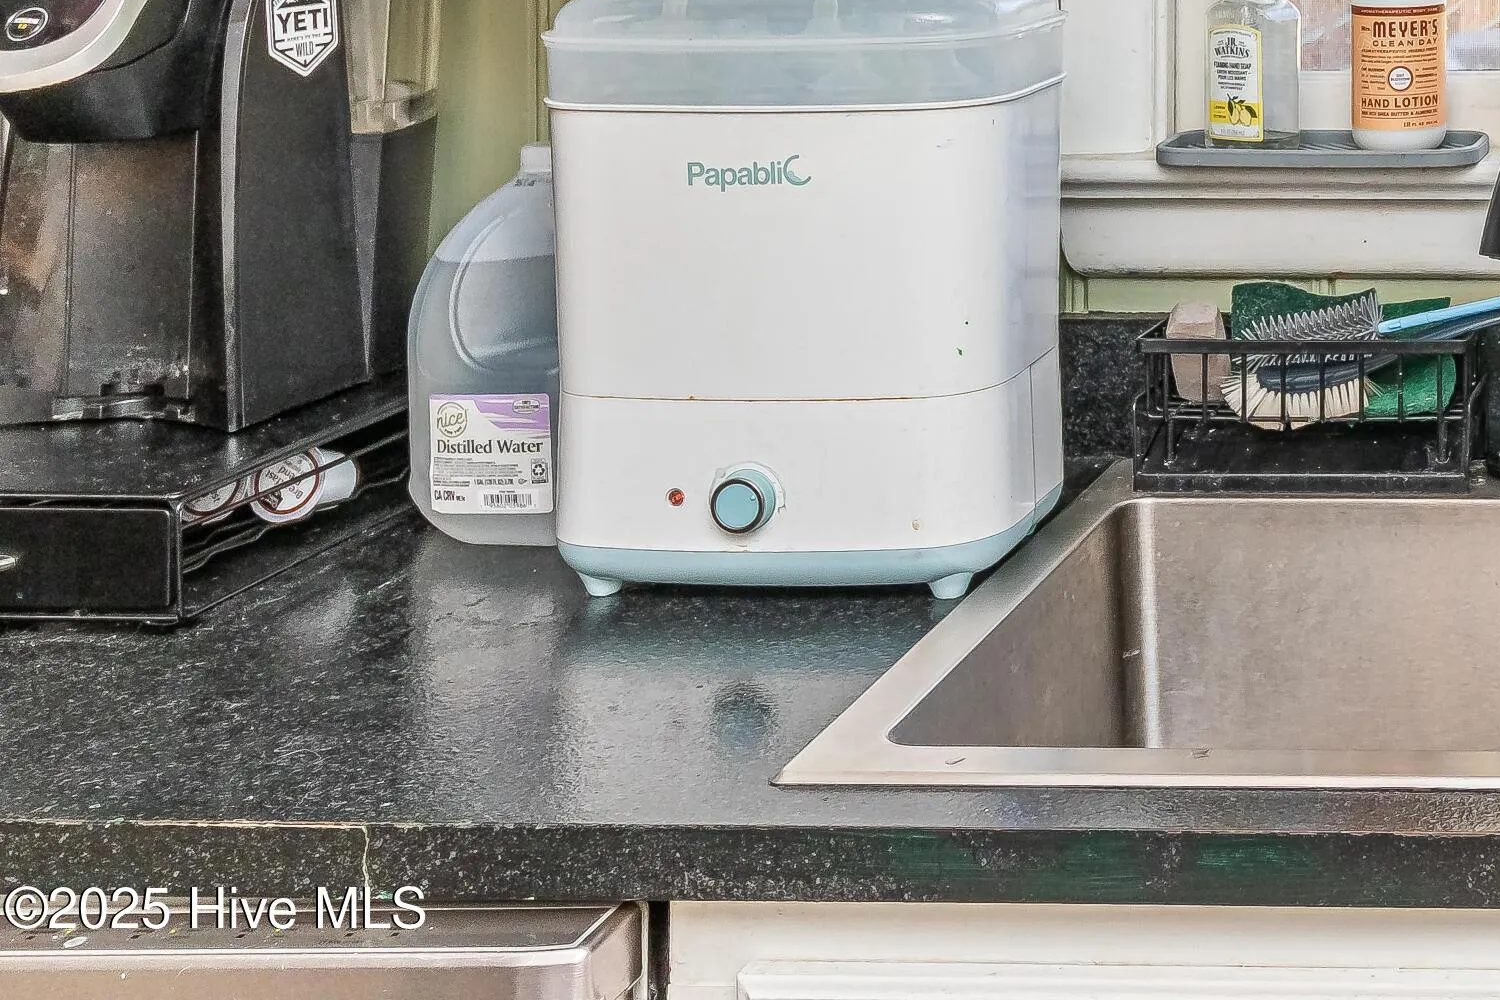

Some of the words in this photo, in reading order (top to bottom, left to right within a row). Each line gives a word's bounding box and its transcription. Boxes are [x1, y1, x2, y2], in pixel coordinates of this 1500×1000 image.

[276, 8, 329, 35] YETI
[1373, 18, 1438, 38] MEYER'S
[1418, 37, 1438, 46] DAY
[295, 41, 314, 57] WILD
[1214, 46, 1250, 58] WATKINS
[1361, 98, 1390, 108] HAND
[1394, 94, 1438, 108] LOTION
[437, 440, 492, 454] Distilled
[497, 440, 544, 453] Water
[434, 490, 443, 500] CA
[444, 490, 455, 502] CRV
